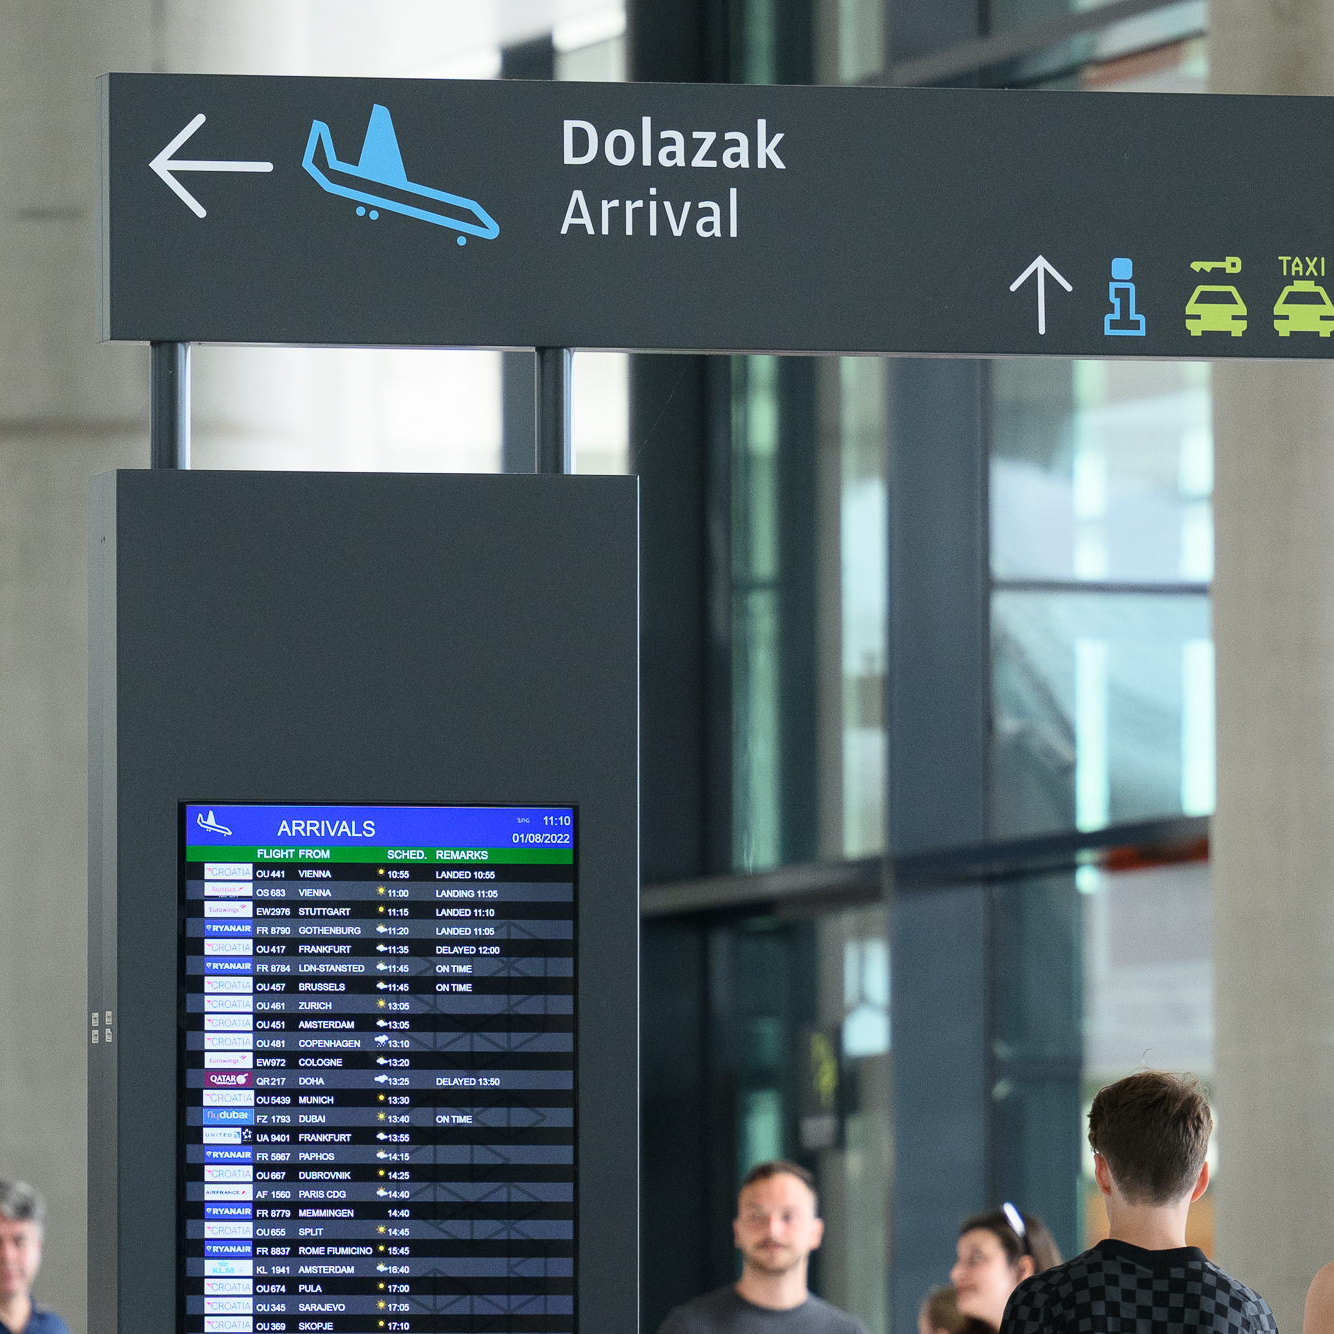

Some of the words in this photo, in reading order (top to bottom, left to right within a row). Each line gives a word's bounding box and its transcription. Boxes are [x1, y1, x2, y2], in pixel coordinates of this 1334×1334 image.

[563, 116, 787, 169] Dolazak
[560, 187, 738, 238] Arrival
[1278, 256, 1325, 276] TAXI
[543, 815, 571, 826] 11:10
[277, 820, 376, 837] ARRIVALS
[512, 832, 570, 844] 01/08/2022
[257, 849, 295, 859] FLIGHT
[298, 849, 330, 859] FROM
[387, 850, 427, 860] SCHED.
[435, 850, 489, 860] REMARKS
[211, 868, 251, 876] CROATIA
[298, 869, 332, 879] VIENNA
[388, 870, 410, 879] 10:55
[436, 870, 472, 880] LANDED
[473, 870, 496, 880] 10:55
[298, 888, 332, 897] VIENNA
[388, 889, 409, 898] 11:00
[436, 889, 475, 898] LANDING
[477, 889, 498, 899] 11:05
[256, 907, 291, 916] EW2976
[298, 907, 351, 916] STUTTGART
[388, 907, 409, 917] 11:15
[436, 908, 472, 917] LANDED
[473, 908, 495, 917] 11:10
[270, 926, 291, 935] 8790
[298, 926, 361, 935] GOTHENBURG
[388, 926, 409, 936] 11:20
[436, 927, 472, 936] LANDED
[474, 927, 495, 936] 11:05
[298, 945, 351, 954] FRANKFURT
[388, 945, 409, 954] 11:35
[436, 945, 477, 955] DELAYED
[478, 946, 500, 955] 12:00
[212, 962, 252, 970] RYANAIR
[270, 964, 291, 973] 8784
[299, 964, 365, 973] LDN-STANSTED
[388, 964, 409, 973] 11:45
[436, 964, 450, 973] ON
[451, 964, 472, 974] TIME
[298, 982, 346, 992] BRUSSELS
[388, 983, 409, 992] 11:45
[435, 983, 450, 992] ON
[451, 983, 472, 992] TIME
[298, 1001, 332, 1010] ZURICH
[388, 1002, 410, 1011] 13:05
[298, 1020, 355, 1029] AMSTERDAM
[388, 1020, 410, 1030] 13:05
[298, 1039, 361, 1048] COPENHAGEN
[388, 1039, 410, 1049] 13:10
[256, 1058, 286, 1067] EW972
[298, 1058, 342, 1067] COLOGNE
[388, 1058, 410, 1067] 13:20
[210, 1074, 237, 1083] QATAR
[299, 1076, 325, 1086] DOHA
[388, 1076, 410, 1086] 13:25
[436, 1077, 476, 1086] DELAYED
[478, 1077, 501, 1086] 13:50
[210, 1094, 253, 1103] CROATIA
[298, 1095, 334, 1105] MUNICH
[388, 1096, 410, 1105] 13:30
[271, 1115, 291, 1124] 1793
[298, 1114, 326, 1124] DUBAI
[388, 1114, 410, 1124] 13:40
[436, 1114, 450, 1124] ON
[451, 1115, 472, 1124] TIME
[270, 1133, 290, 1143] 9401
[298, 1133, 352, 1143] FRANKFURT
[388, 1133, 410, 1143] 13:55
[271, 1152, 291, 1162] 5867
[299, 1152, 335, 1161] PAPHOS
[388, 1152, 410, 1161] 14:15
[298, 1171, 351, 1180] DUBROVNIK
[388, 1171, 410, 1180] 14:25
[271, 1190, 291, 1199] 1560
[299, 1189, 325, 1199] PARIS
[326, 1190, 347, 1199] CDG
[388, 1190, 410, 1199] 14:40
[270, 1209, 291, 1218] 8779
[298, 1208, 354, 1218] MEMMINGEN
[388, 1209, 410, 1218] 14:40
[298, 1227, 323, 1237] SPLIT
[388, 1227, 410, 1237] 14:45
[270, 1246, 291, 1256] 8837
[299, 1246, 325, 1255] ROME
[327, 1246, 373, 1255] FIUMICINO
[388, 1246, 410, 1256] 15:45
[212, 1266, 235, 1274] KLM
[271, 1265, 290, 1275] 1941
[298, 1265, 355, 1274] AMSTERDAM
[388, 1265, 410, 1274] 16:40
[298, 1284, 322, 1293] PULA
[388, 1284, 410, 1293] 17:00
[299, 1303, 346, 1312] SARAJEVO
[388, 1303, 410, 1312] 17:05
[211, 1321, 251, 1329] CROATIA
[298, 1321, 333, 1331] SKOPJE
[388, 1321, 410, 1331] 17:10
